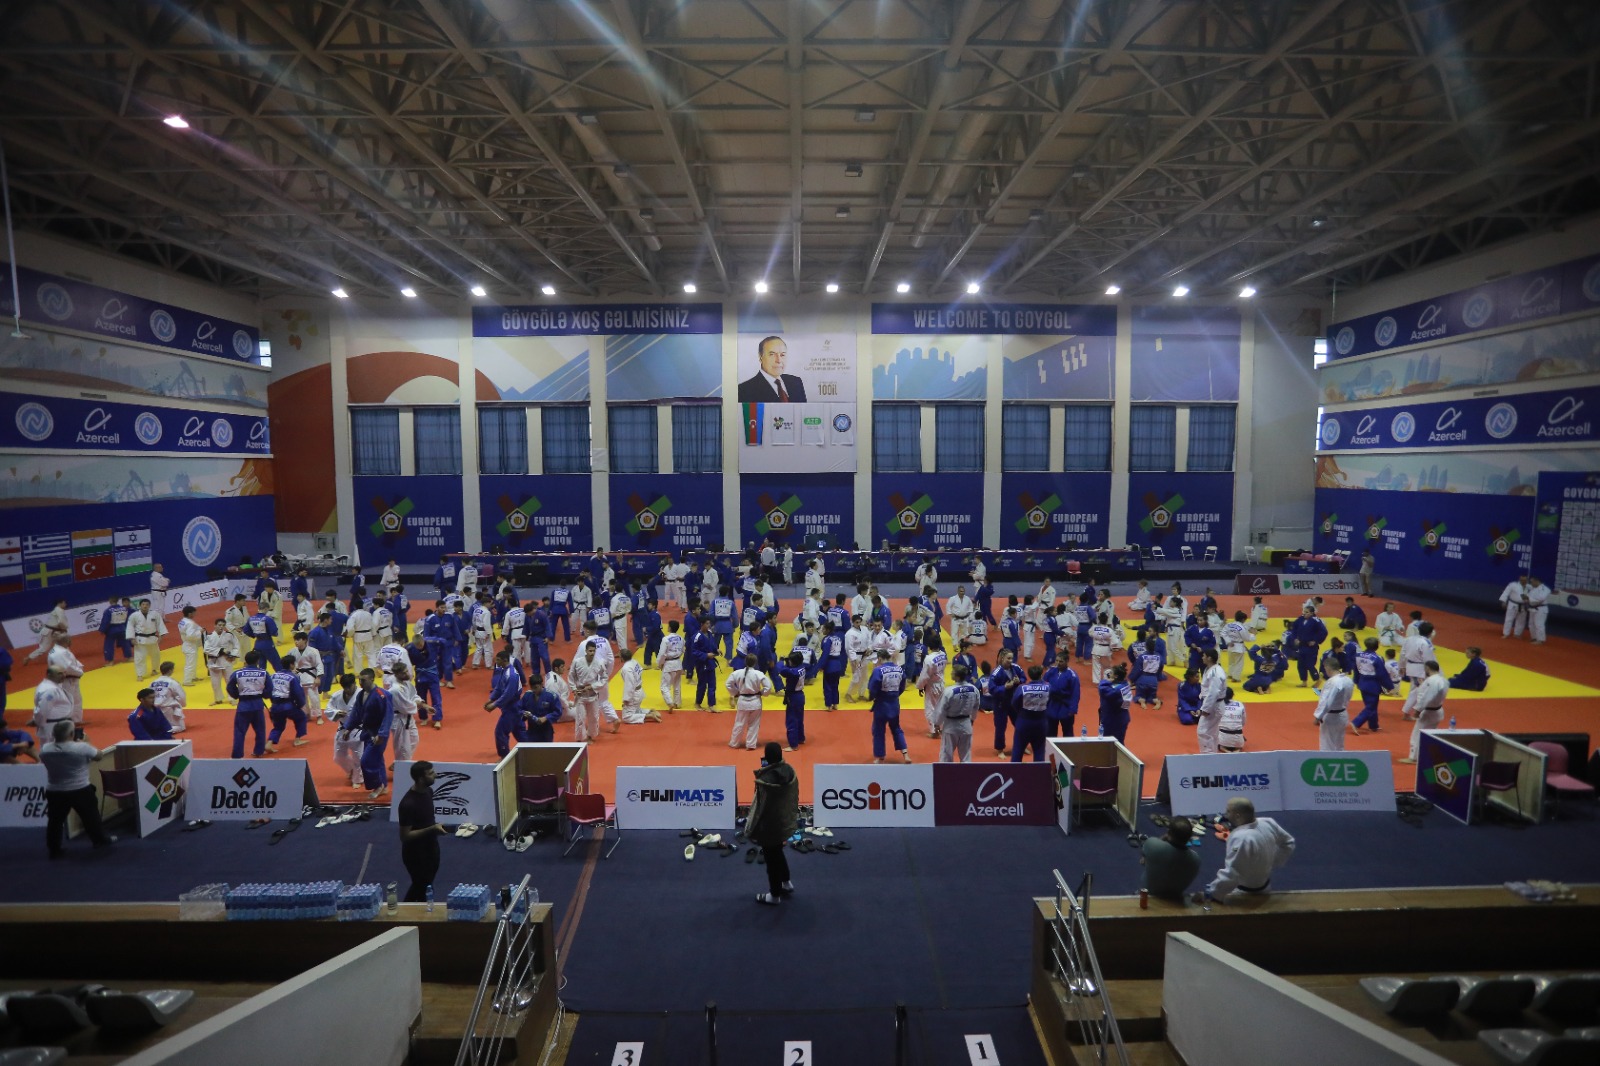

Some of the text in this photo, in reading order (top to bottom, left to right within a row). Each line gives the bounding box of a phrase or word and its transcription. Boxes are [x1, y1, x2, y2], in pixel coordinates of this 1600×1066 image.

[571, 311, 600, 332] XOŞ
[914, 309, 1072, 329] WELCOME TO GOYGOL
[94, 318, 137, 336] Azercell
[1410, 324, 1447, 341] Azercell
[191, 338, 223, 354] Azercell
[1536, 422, 1591, 438] Azercell
[76, 431, 120, 445] Azercell
[1350, 434, 1380, 445] Azercell
[1428, 429, 1467, 442] Azercell
[177, 436, 211, 448] Azercell
[245, 440, 270, 450] Azerce
[407, 516, 452, 526] EUROPEAN
[534, 516, 580, 526] EUROPEAN
[663, 515, 711, 525] EUROPEAN
[793, 514, 841, 525] EUROPEAN
[925, 514, 971, 524] EUROPEAN
[1053, 513, 1098, 523] EUROPEAN
[1176, 513, 1220, 523] EUROPEAN
[418, 526, 441, 536] JUDO
[545, 526, 569, 536] JUDO
[675, 525, 699, 535] JUDO
[805, 524, 829, 534] JUDO
[936, 524, 959, 534] JUDO
[1063, 523, 1087, 533] JUDO
[1186, 523, 1209, 532] JUDO
[416, 536, 444, 546] UNION
[543, 536, 572, 545] UNION
[673, 535, 702, 545] UNION
[933, 534, 962, 544] UNION
[1061, 533, 1089, 543] UNION
[1184, 532, 1211, 542] UNION
[1513, 543, 1531, 552] EURO
[1323, 579, 1359, 590] essimo
[1313, 763, 1357, 782] AZE
[1192, 773, 1270, 789] FUJIMATS
[4, 786, 48, 802] IPPON
[640, 788, 725, 802] FUJIMATS
[821, 782, 927, 811] essimo
[23, 802, 49, 818] GEA
[435, 806, 469, 816] EBRA
[965, 802, 1024, 817] Azercell
[975, 1041, 990, 1060] 1
[617, 1049, 634, 1066] 3
[791, 1047, 805, 1066] 2
